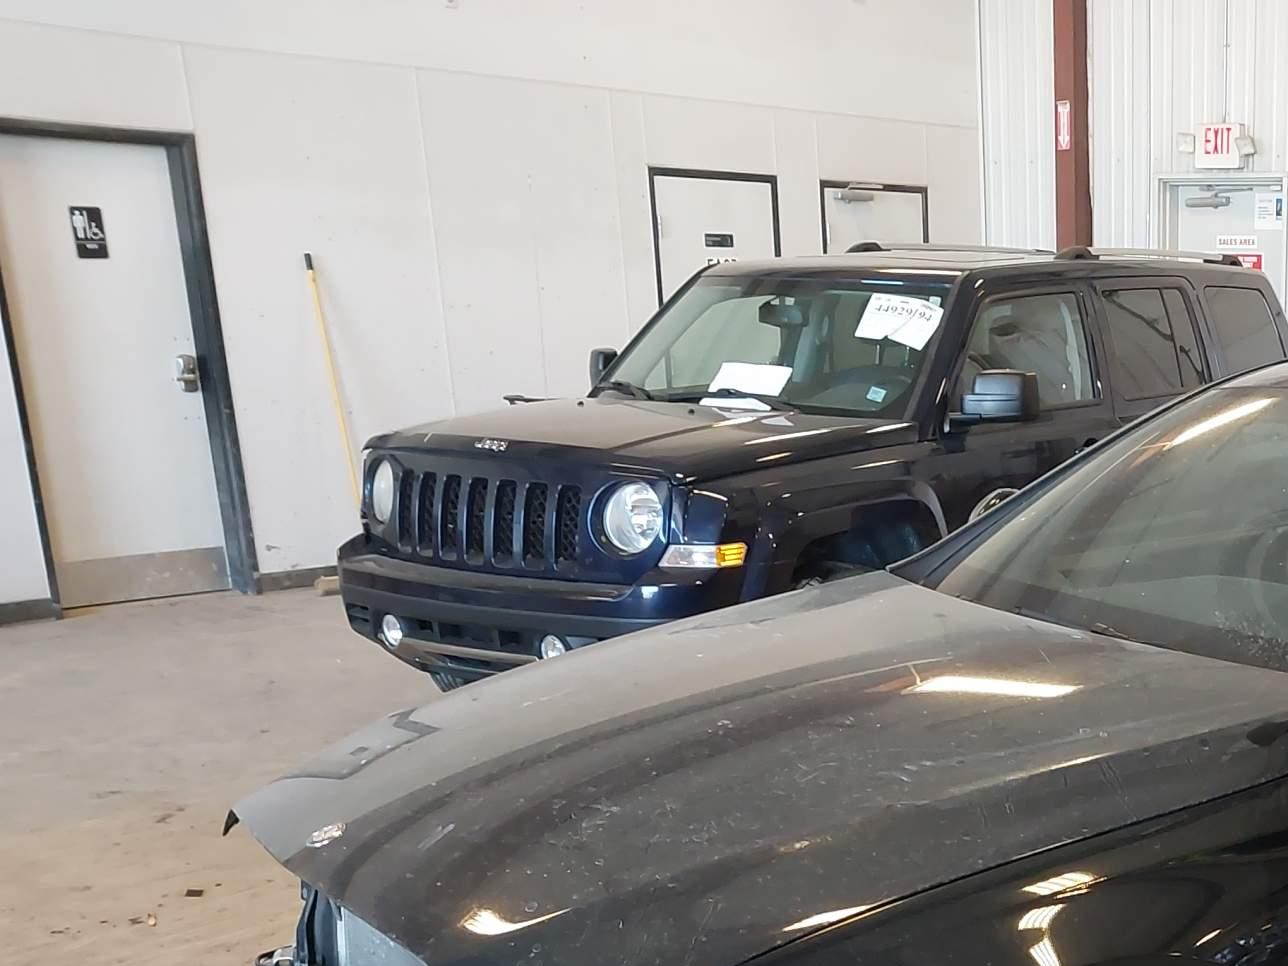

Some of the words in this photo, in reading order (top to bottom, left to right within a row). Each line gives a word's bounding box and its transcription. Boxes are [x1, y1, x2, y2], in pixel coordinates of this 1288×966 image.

[1204, 127, 1232, 154] EXIT
[1218, 238, 1237, 246] SALES
[1239, 238, 1256, 246] AREA
